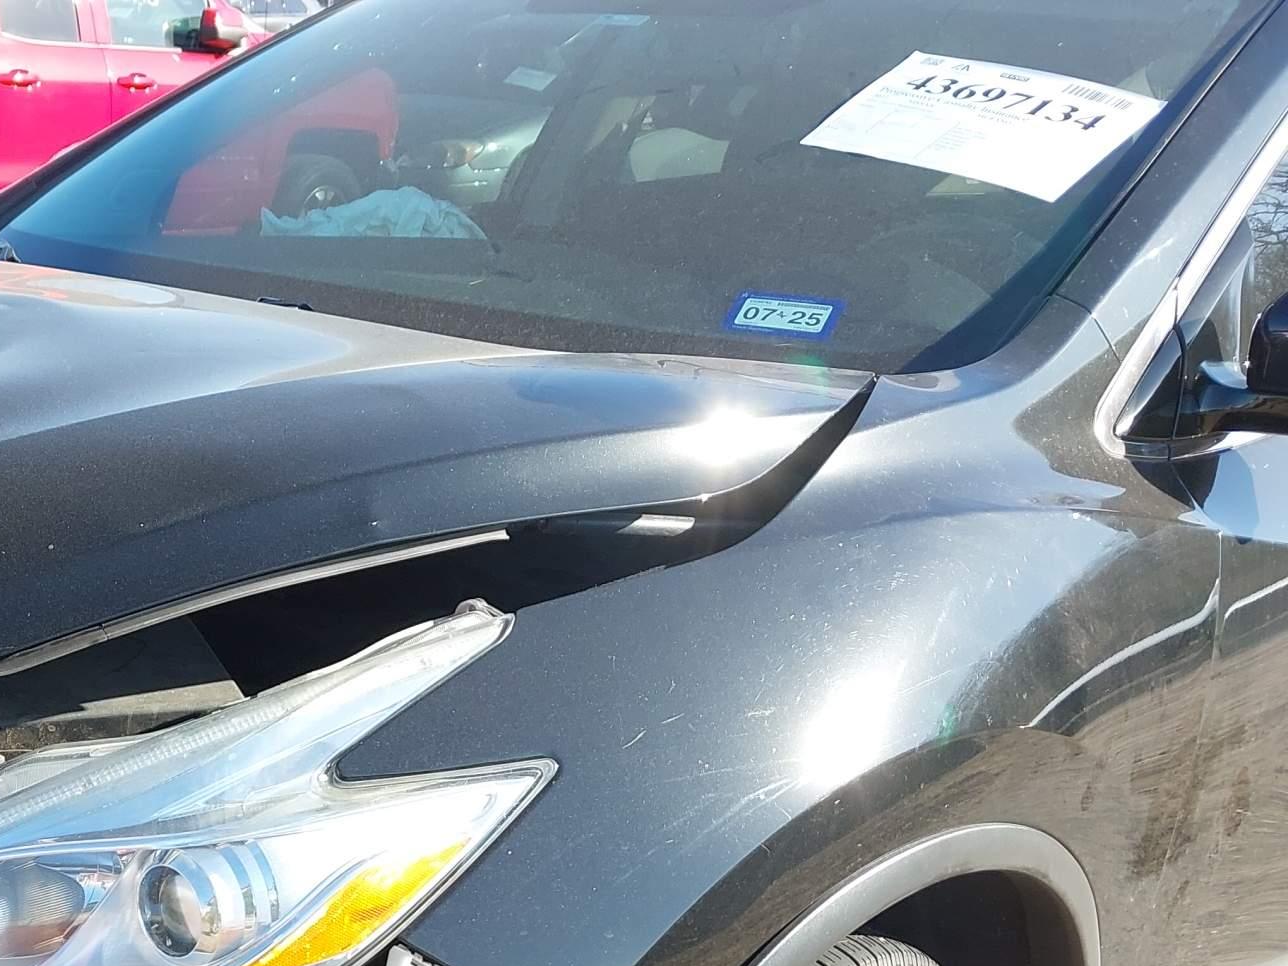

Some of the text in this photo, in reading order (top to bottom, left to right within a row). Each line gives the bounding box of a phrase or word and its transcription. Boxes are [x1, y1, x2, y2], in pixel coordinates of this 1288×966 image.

[906, 74, 1107, 132] 43697134
[742, 306, 778, 321] 07
[787, 310, 824, 327] 25
